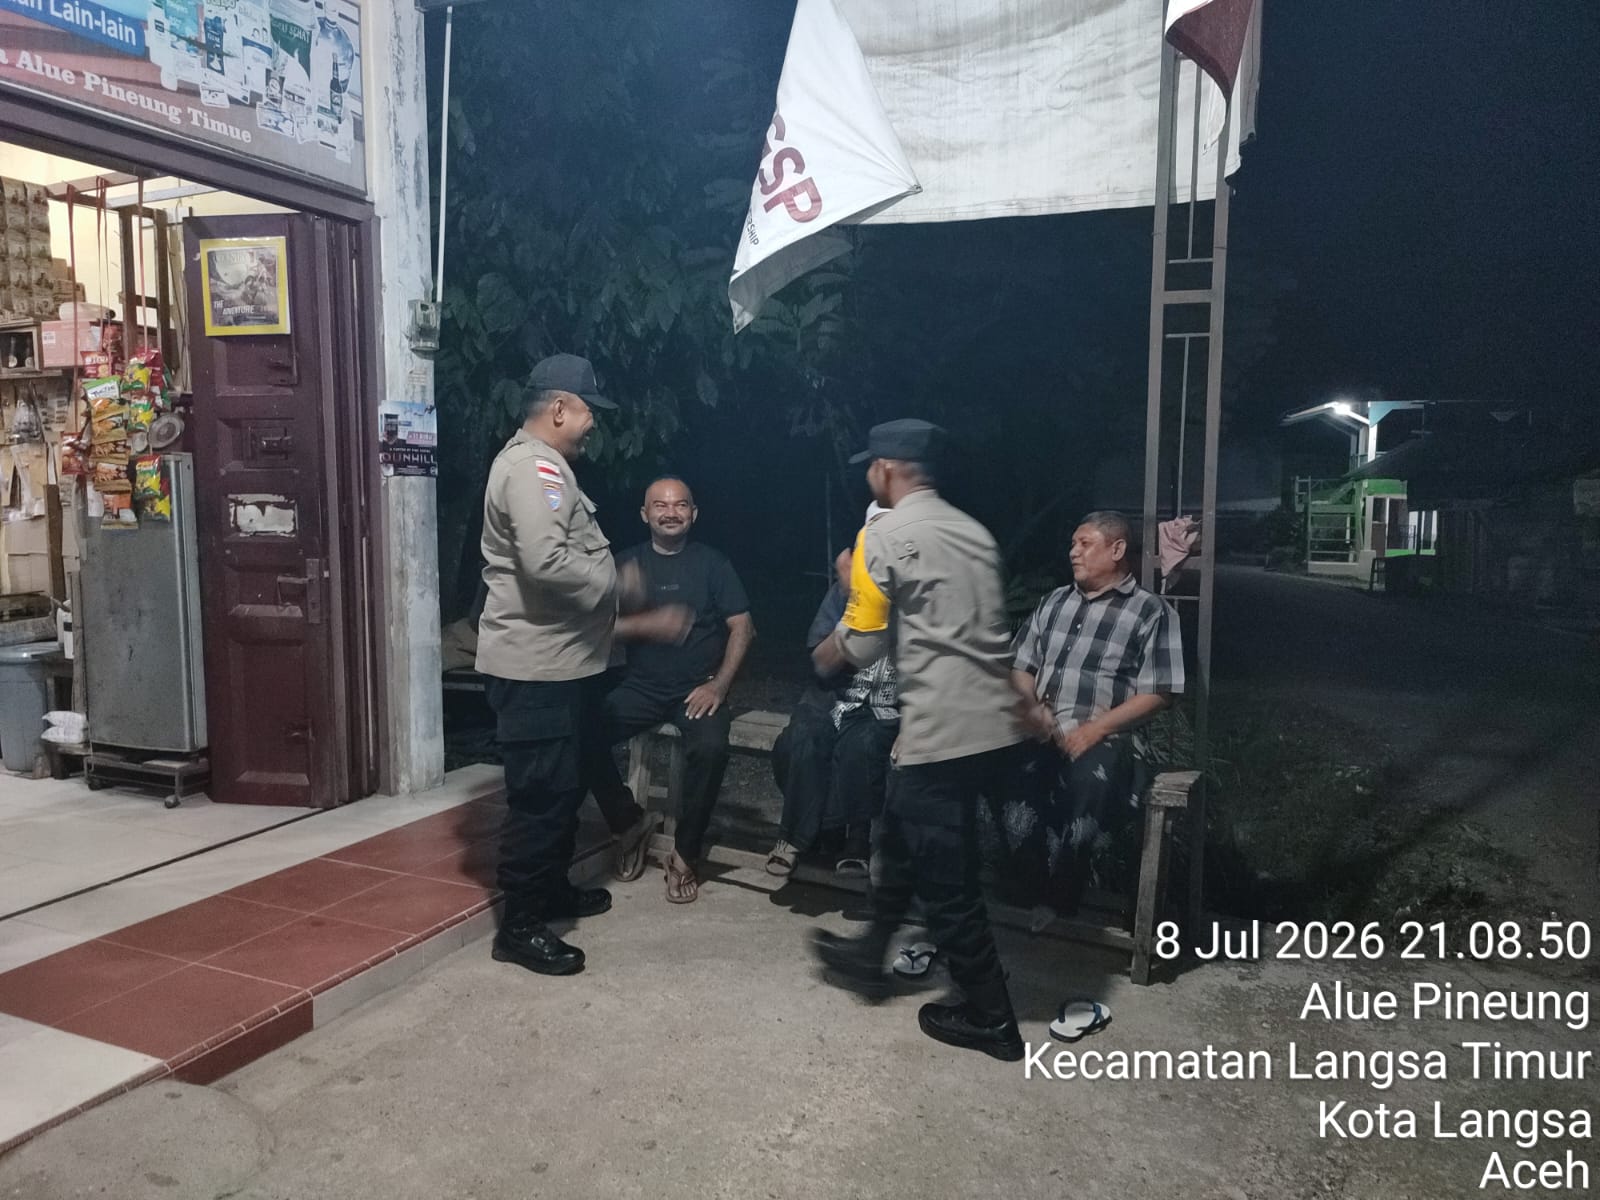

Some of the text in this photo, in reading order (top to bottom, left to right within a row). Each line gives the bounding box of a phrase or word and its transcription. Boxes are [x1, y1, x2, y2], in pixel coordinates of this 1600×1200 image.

[50, 0, 136, 46] Lain-lain
[16, 50, 75, 85] Alue
[83, 71, 182, 125] Pineung
[187, 107, 252, 144] Timue
